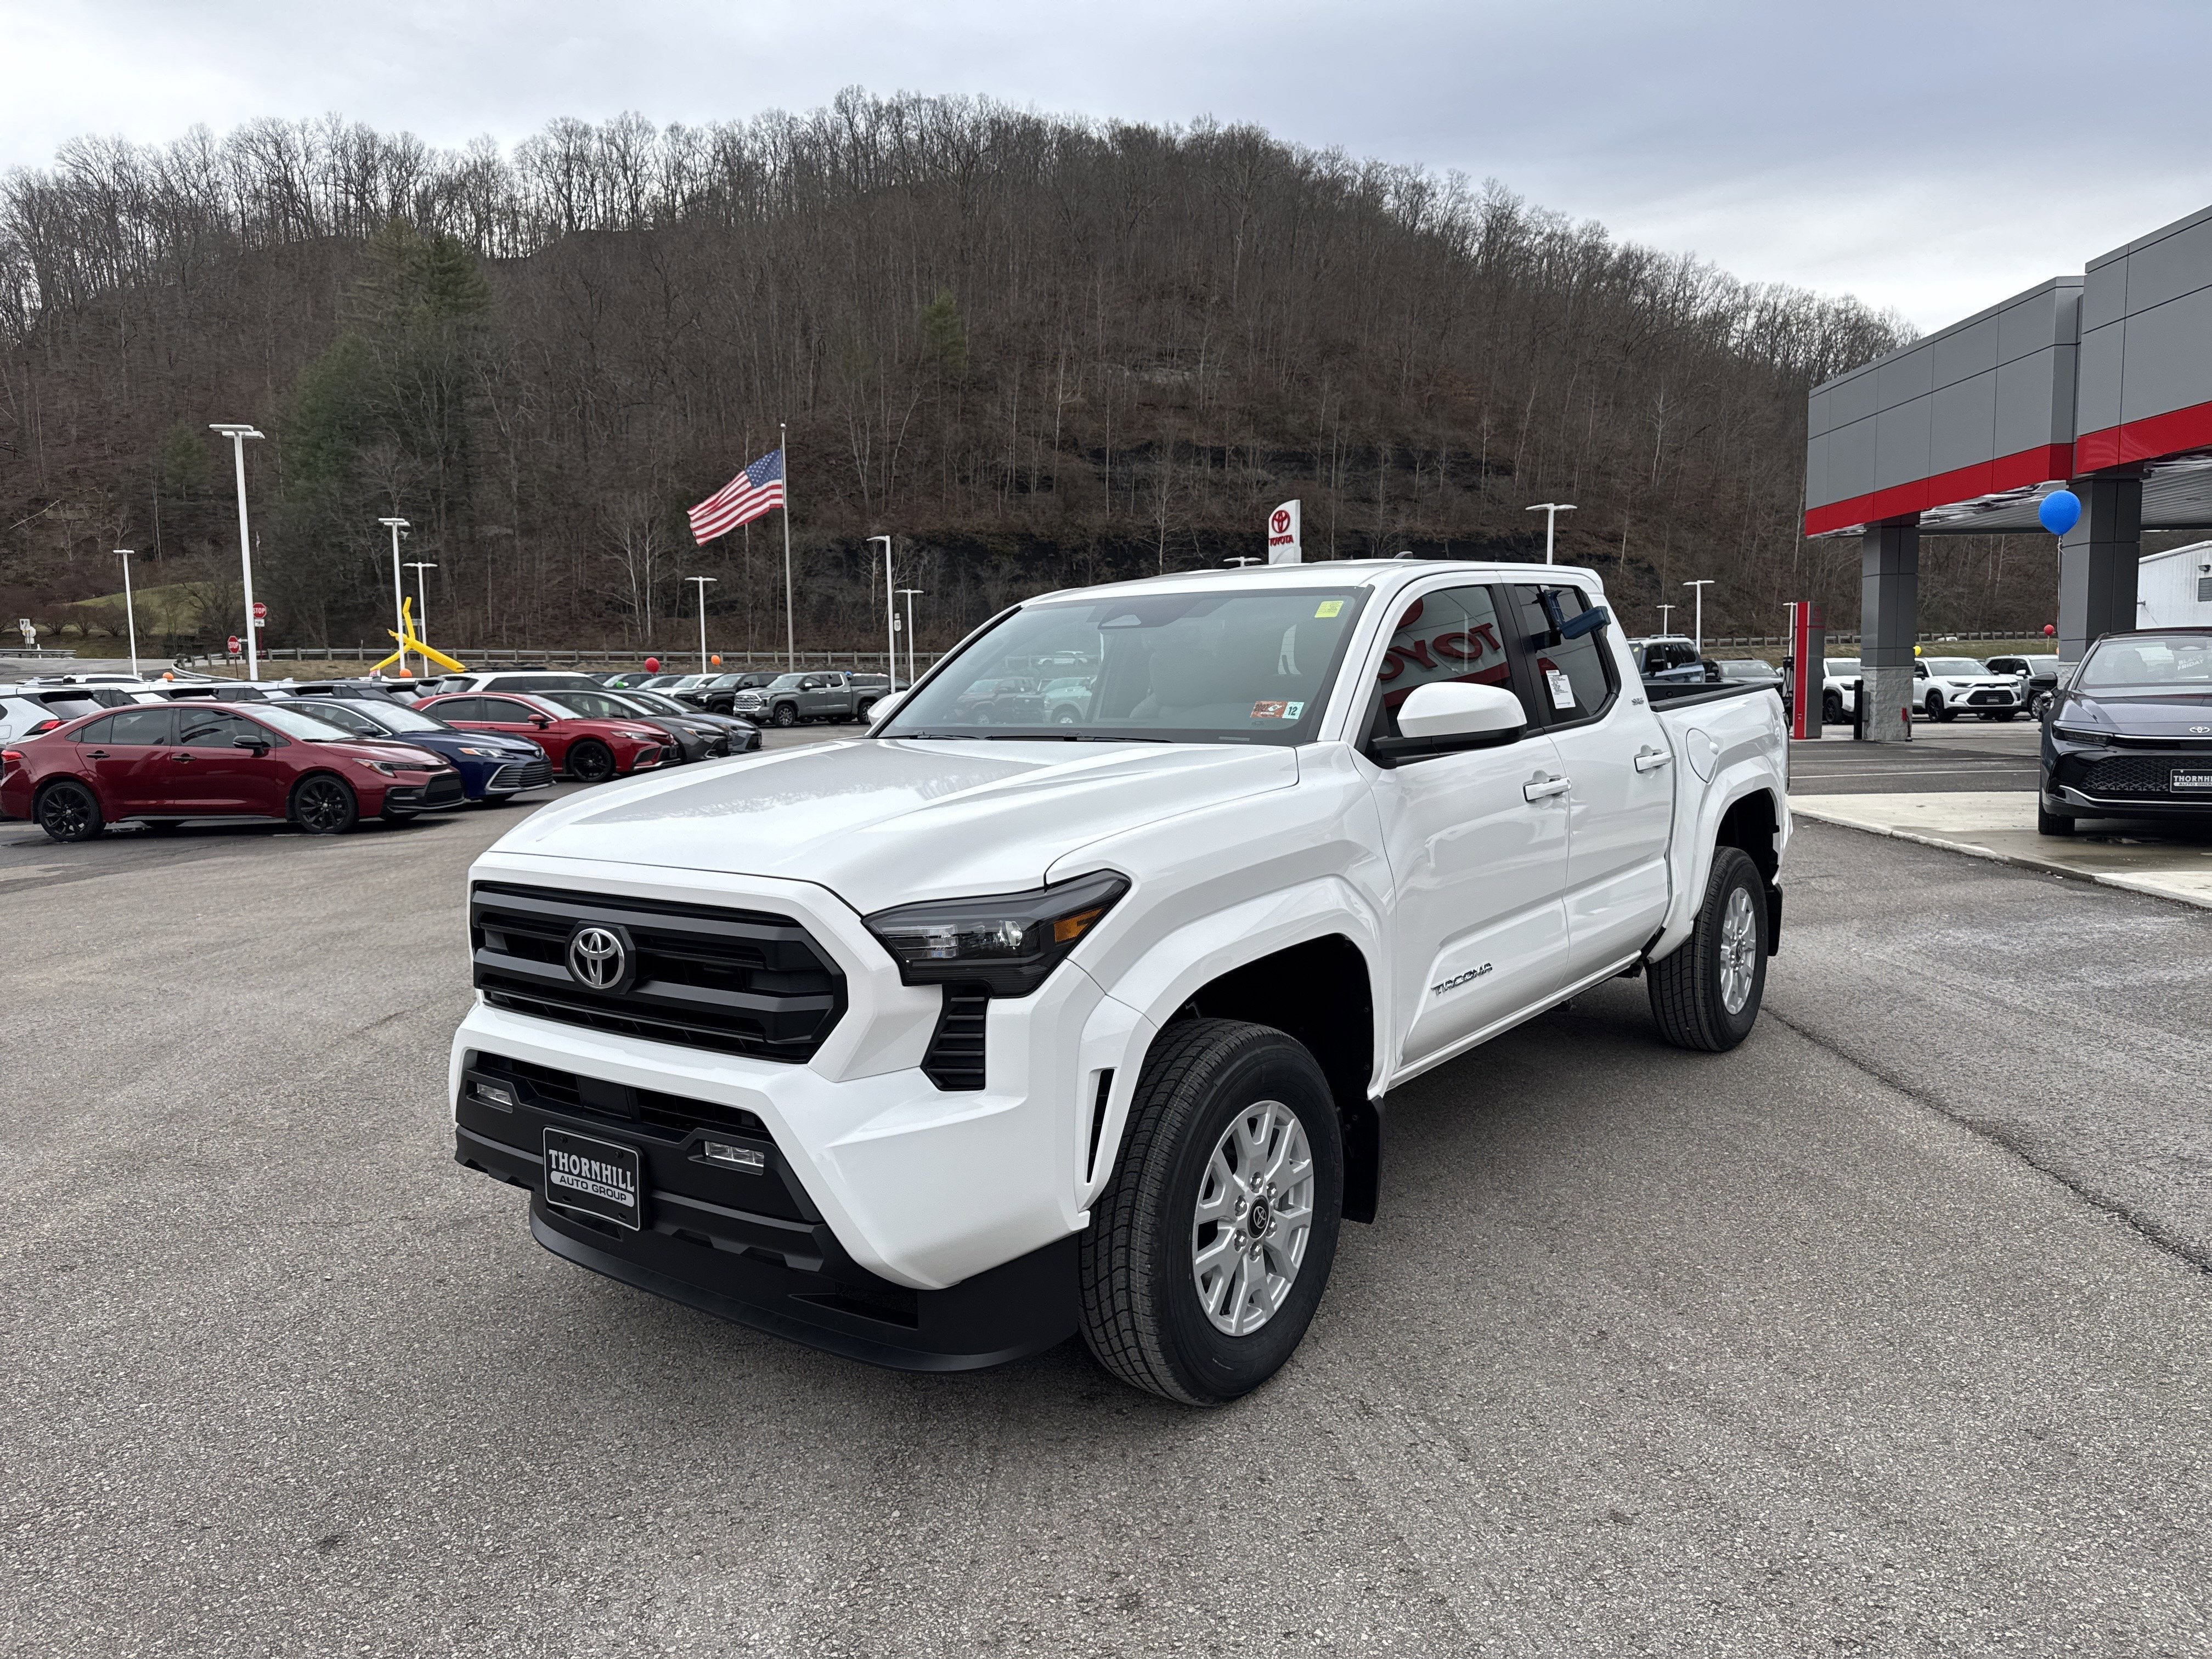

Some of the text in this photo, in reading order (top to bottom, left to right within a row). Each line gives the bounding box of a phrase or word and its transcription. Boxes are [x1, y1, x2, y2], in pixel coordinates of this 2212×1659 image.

[1269, 535, 1294, 546] TOYOTA
[2177, 658, 2203, 670] FRIDAY
[1288, 706, 1298, 716] 12
[1430, 962, 1493, 996] TACOMA
[549, 1149, 635, 1192] THORNHILL
[559, 1175, 627, 1201] AUTO GROUP
